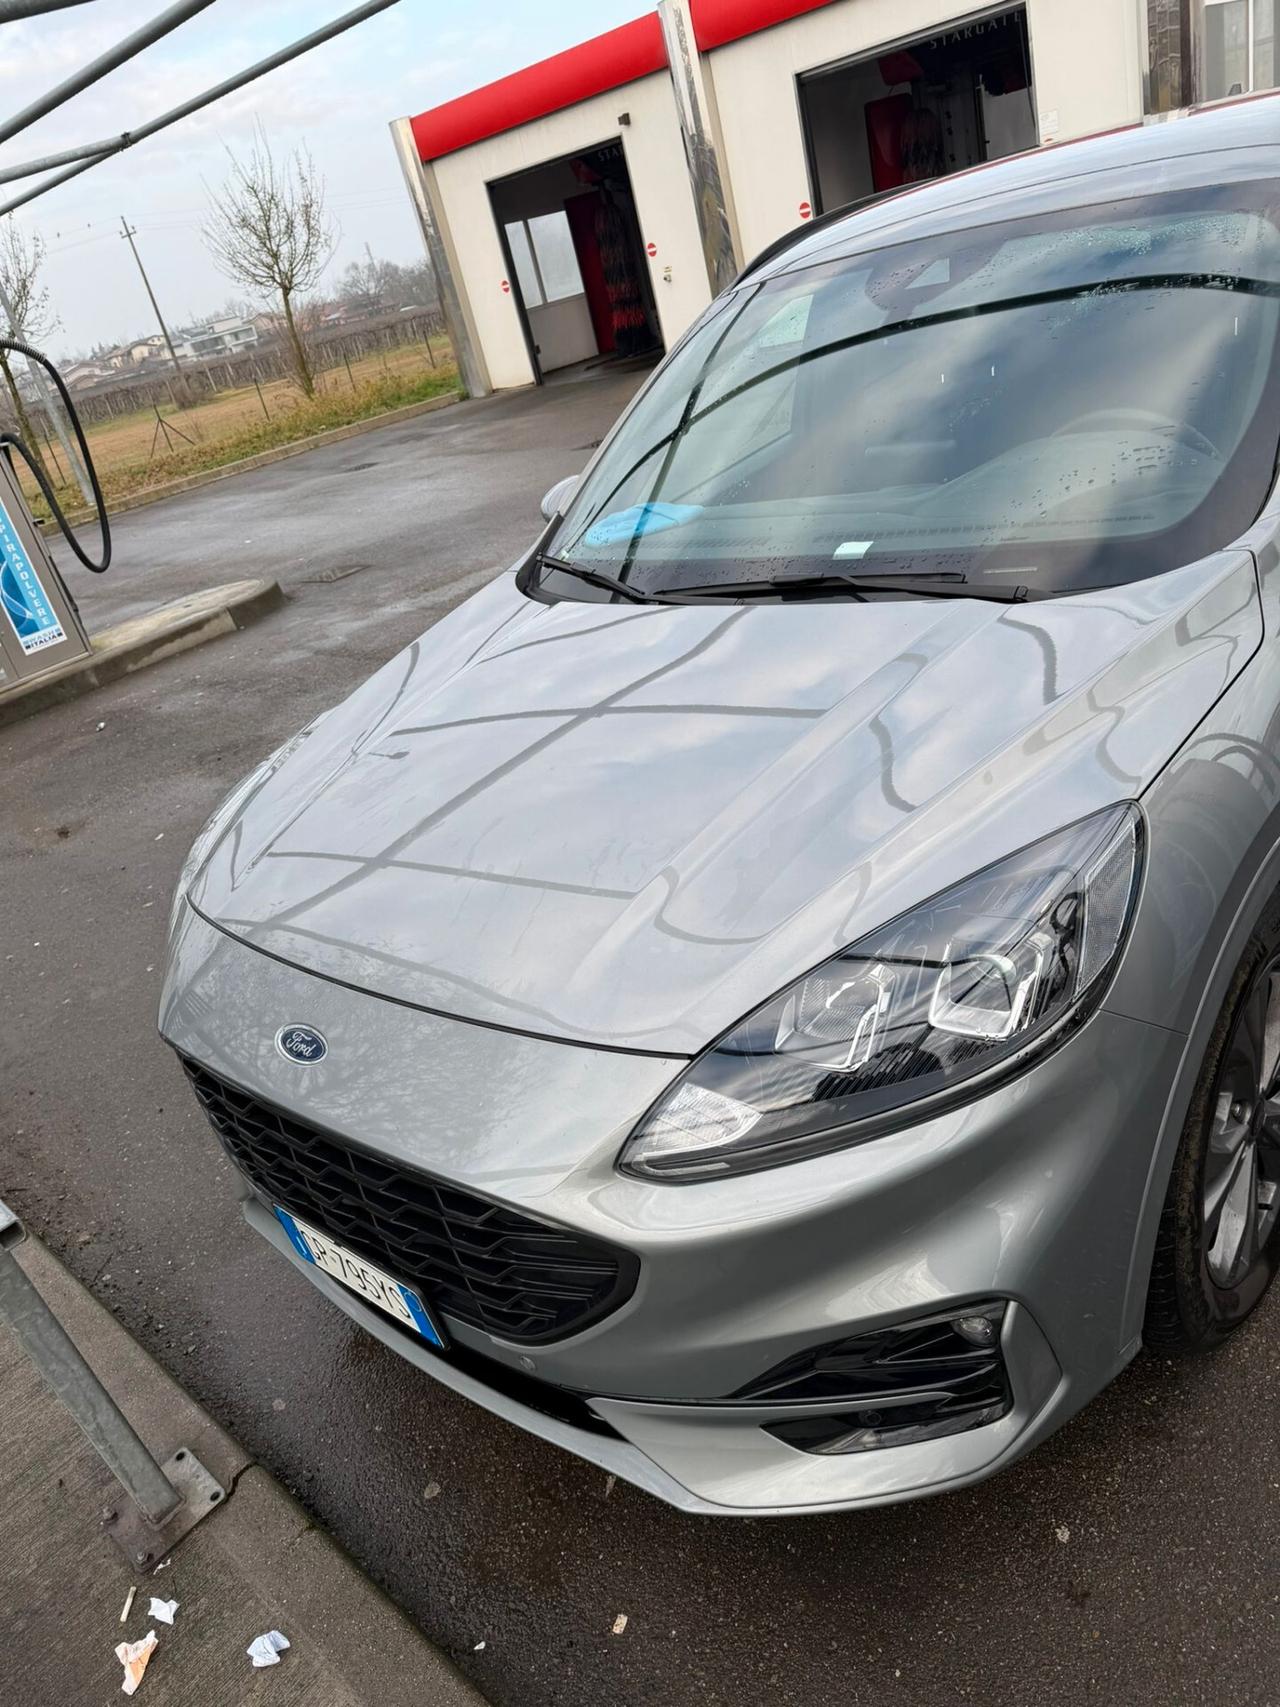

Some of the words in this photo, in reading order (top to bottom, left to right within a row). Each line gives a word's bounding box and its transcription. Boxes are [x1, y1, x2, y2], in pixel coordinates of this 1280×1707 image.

[0, 516, 52, 627] PIRAPOLVERE
[30, 634, 57, 648] ITALIA
[286, 1031, 317, 1057] Ford
